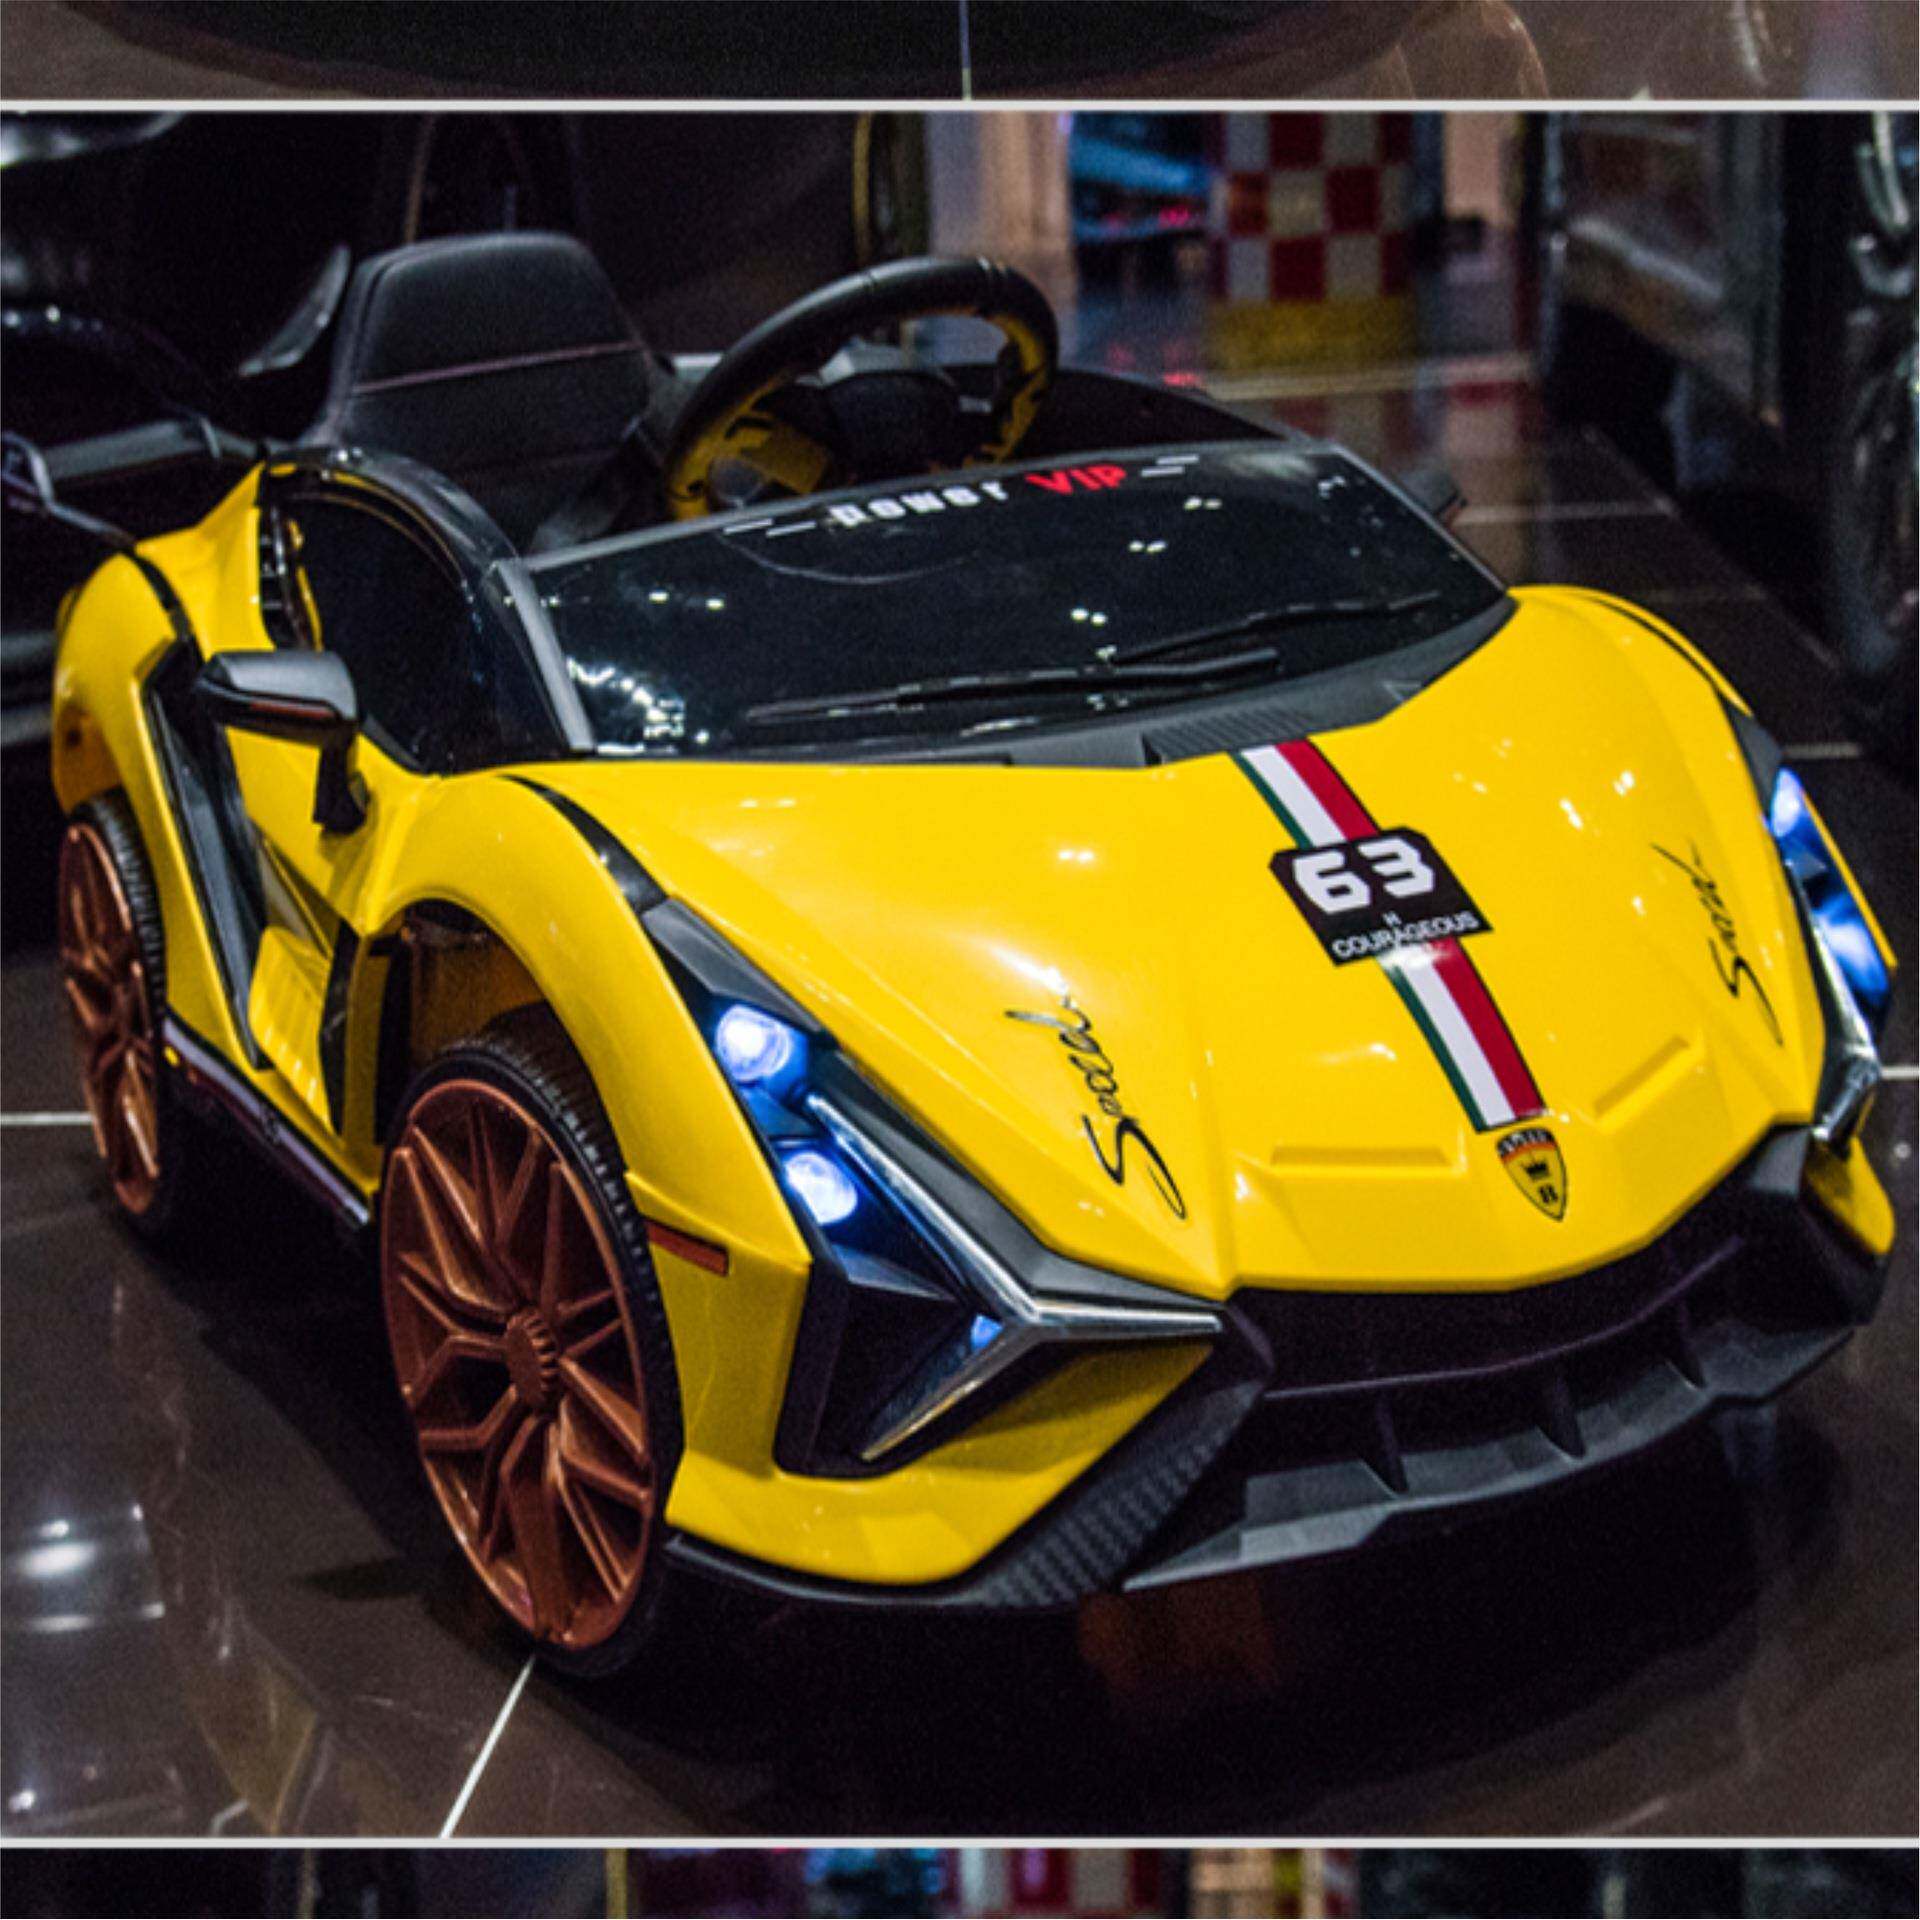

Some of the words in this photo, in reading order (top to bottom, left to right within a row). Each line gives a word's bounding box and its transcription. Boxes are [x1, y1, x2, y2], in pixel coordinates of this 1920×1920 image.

[1024, 464, 1127, 495] VIP
[1292, 835, 1435, 915] 63
[1331, 910, 1480, 958] COURAGEOUS
